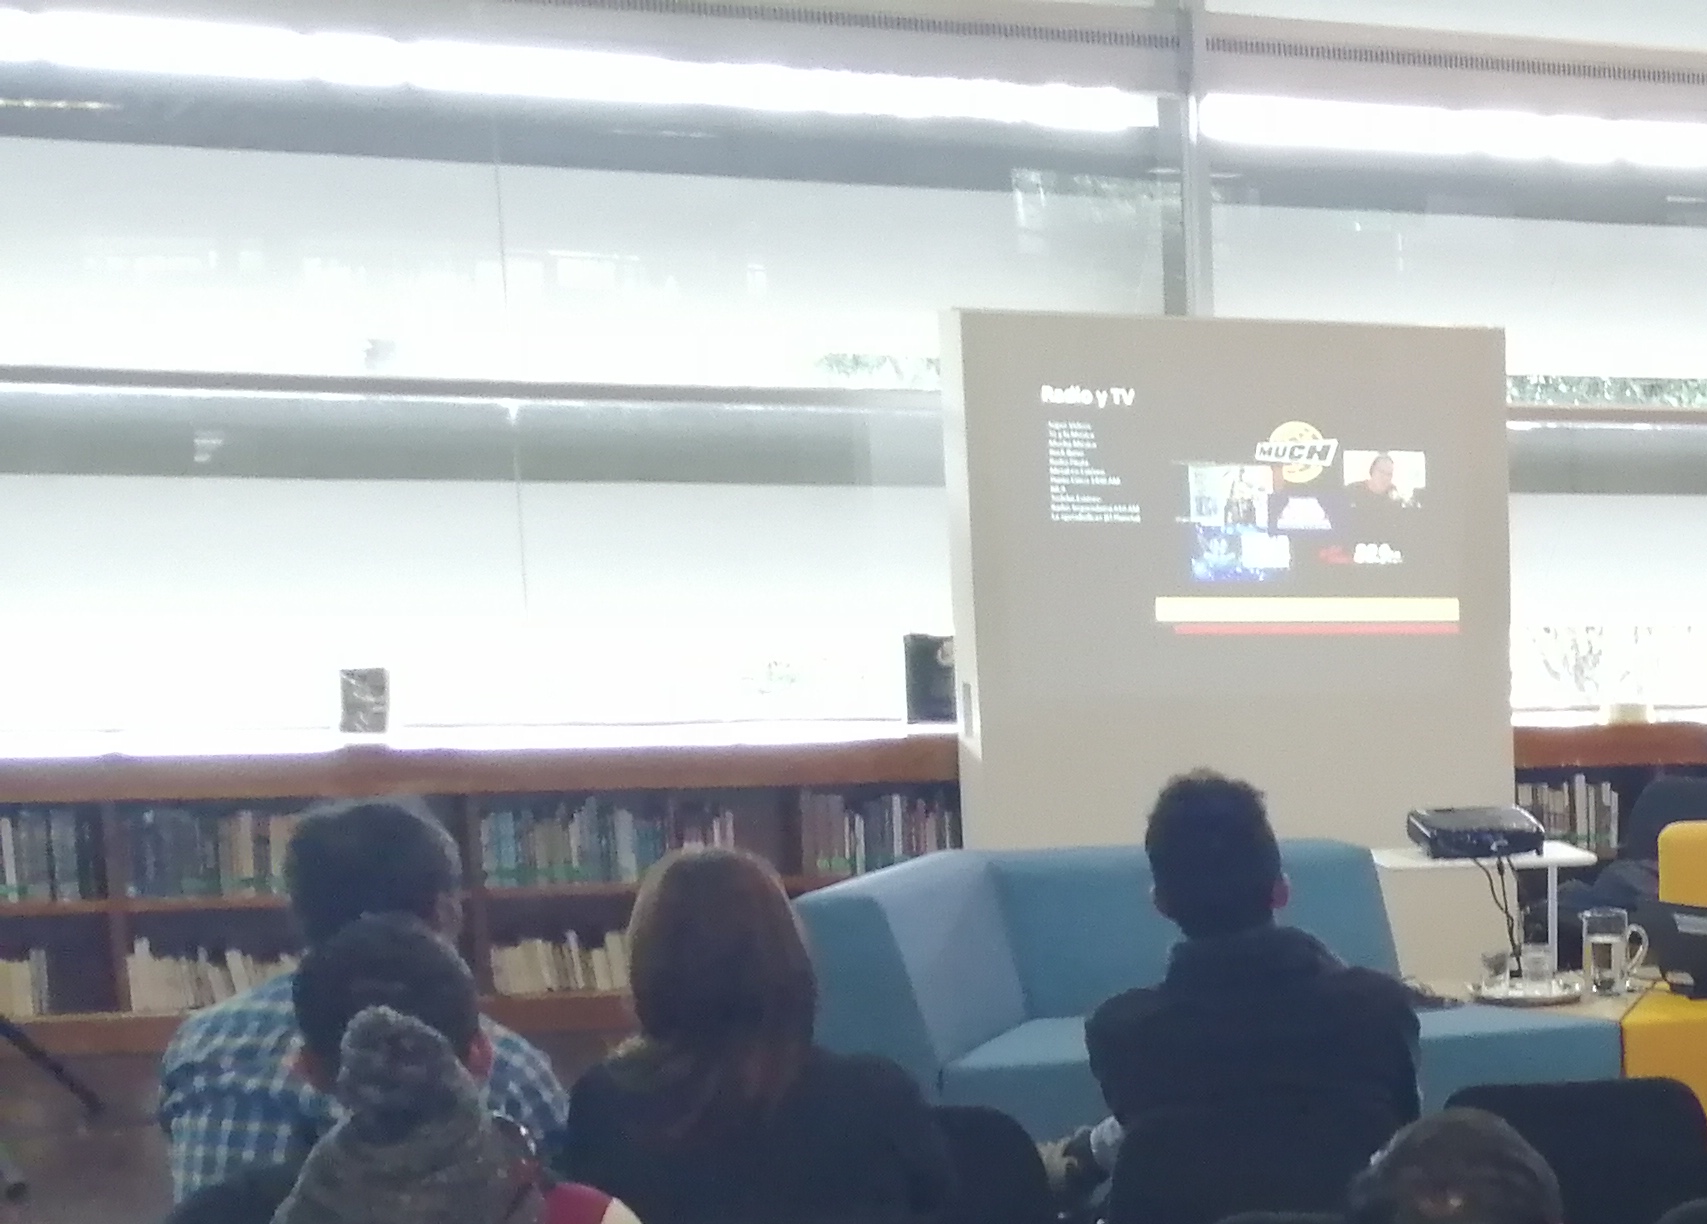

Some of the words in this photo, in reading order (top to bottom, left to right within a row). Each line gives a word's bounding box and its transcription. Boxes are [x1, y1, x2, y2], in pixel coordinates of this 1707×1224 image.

[1041, 384, 1094, 405] Radio
[1095, 389, 1108, 408] y
[1109, 386, 1135, 406] TV
